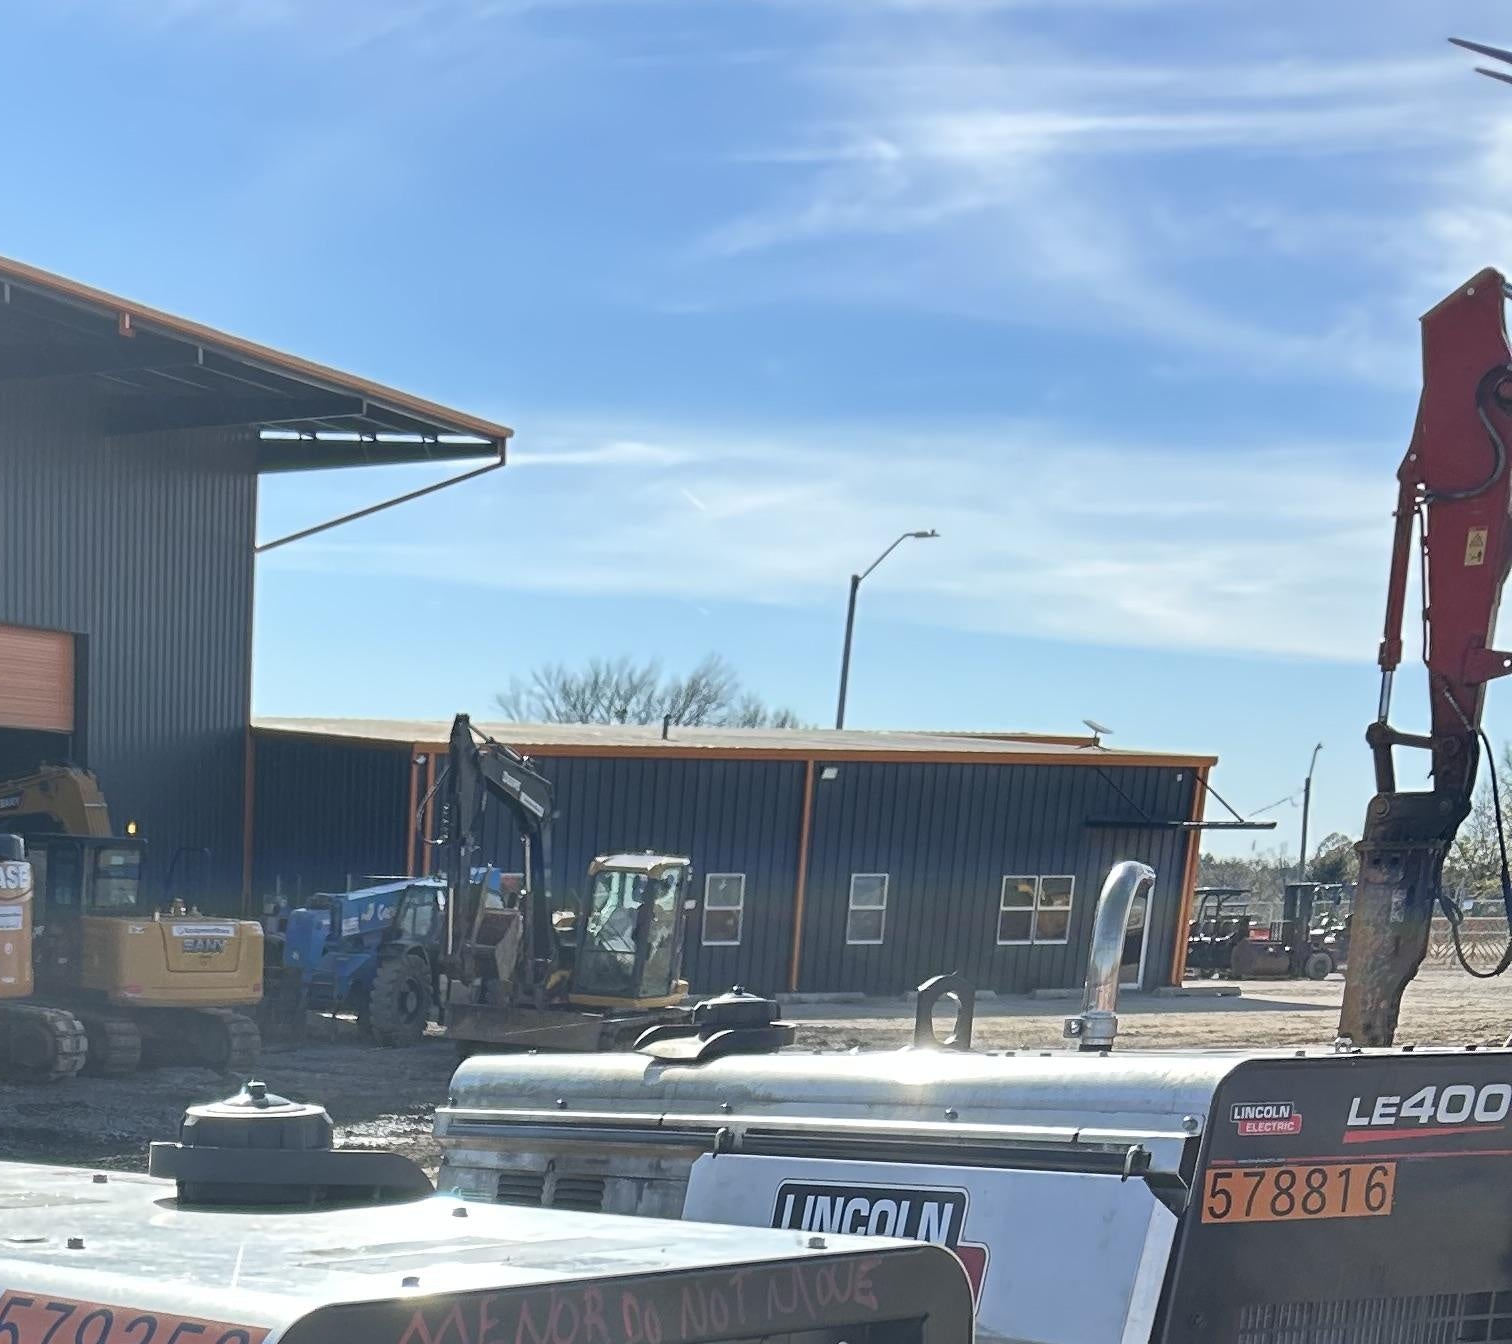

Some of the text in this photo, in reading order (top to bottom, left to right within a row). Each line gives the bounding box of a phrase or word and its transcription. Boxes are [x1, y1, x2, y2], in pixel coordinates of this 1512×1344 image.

[1234, 1105, 1290, 1119] LINCOLN
[1347, 1083, 1511, 1126] LE400
[1245, 1121, 1294, 1132] ELECTRIC
[1208, 1166, 1388, 1219] 578816
[781, 1194, 954, 1246] LINCOLN
